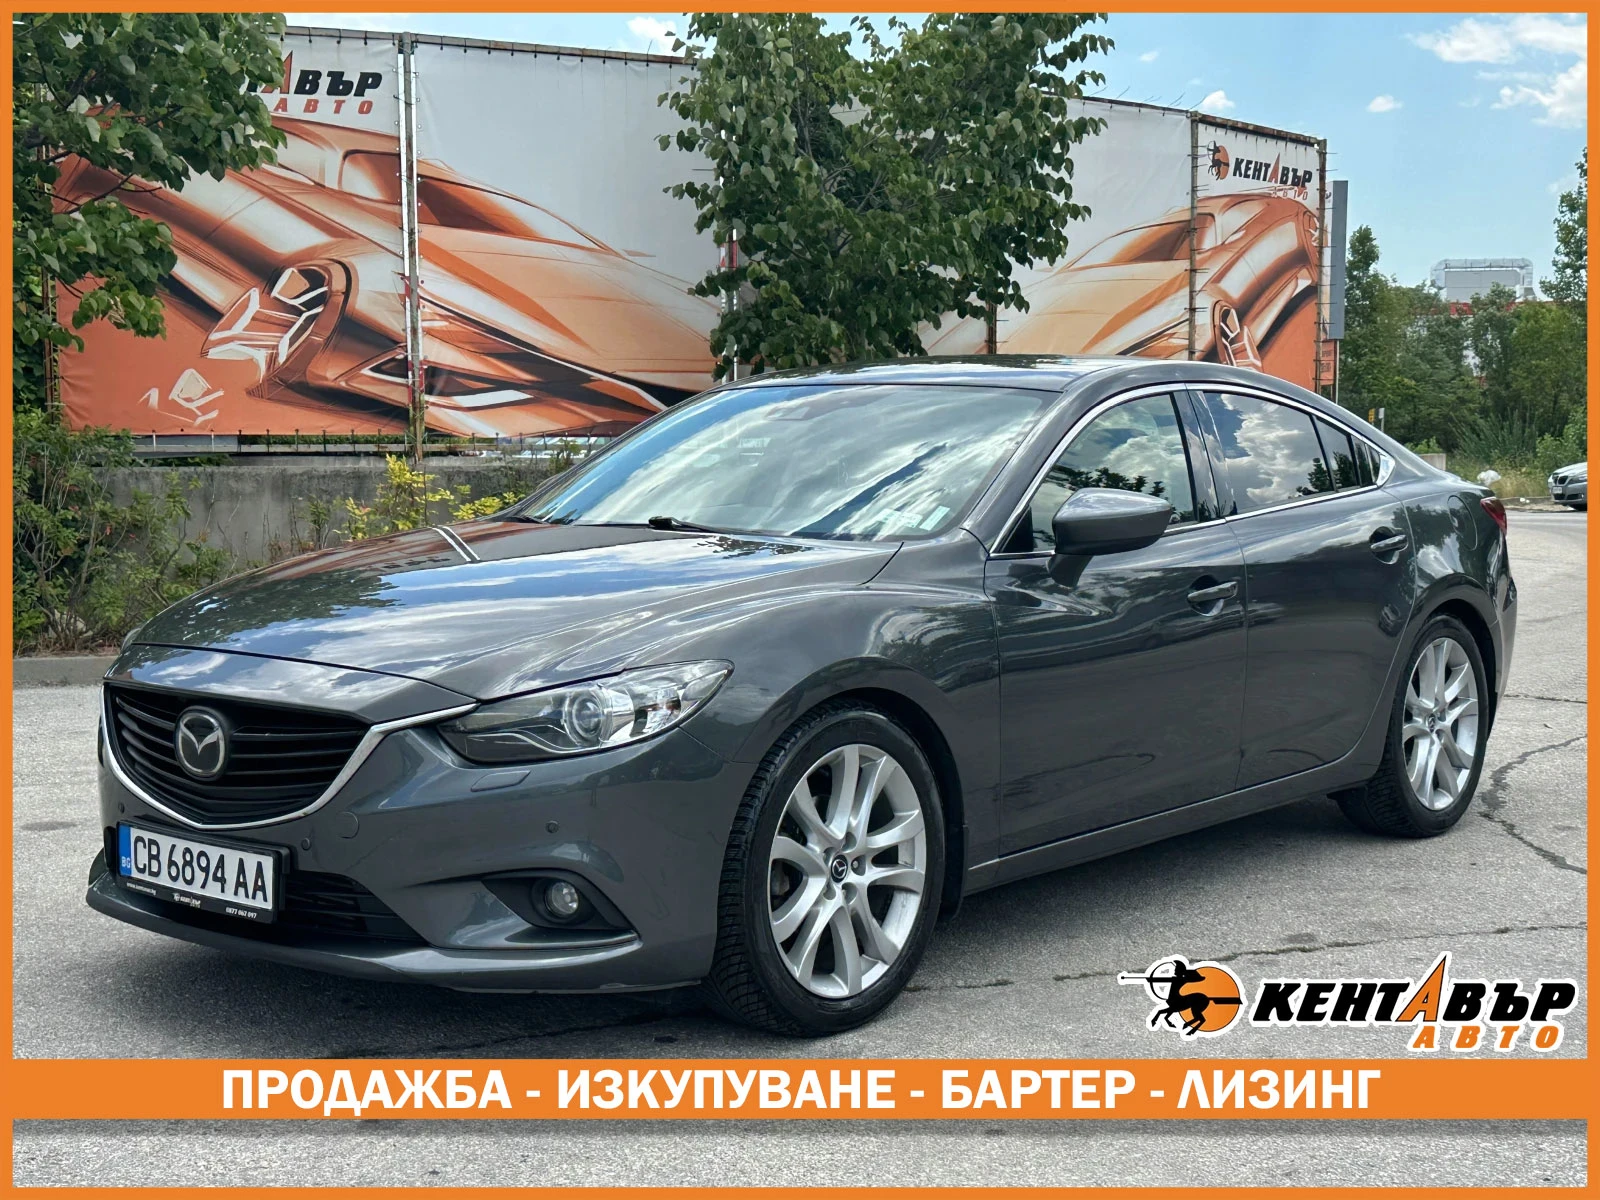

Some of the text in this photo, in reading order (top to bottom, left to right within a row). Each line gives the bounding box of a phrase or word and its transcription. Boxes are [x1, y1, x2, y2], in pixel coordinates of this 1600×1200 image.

[273, 97, 374, 115] АВТО
[1232, 152, 1313, 188] КЕНТАВЪР
[121, 856, 131, 868] BG
[133, 835, 268, 903] CB 6894 AA
